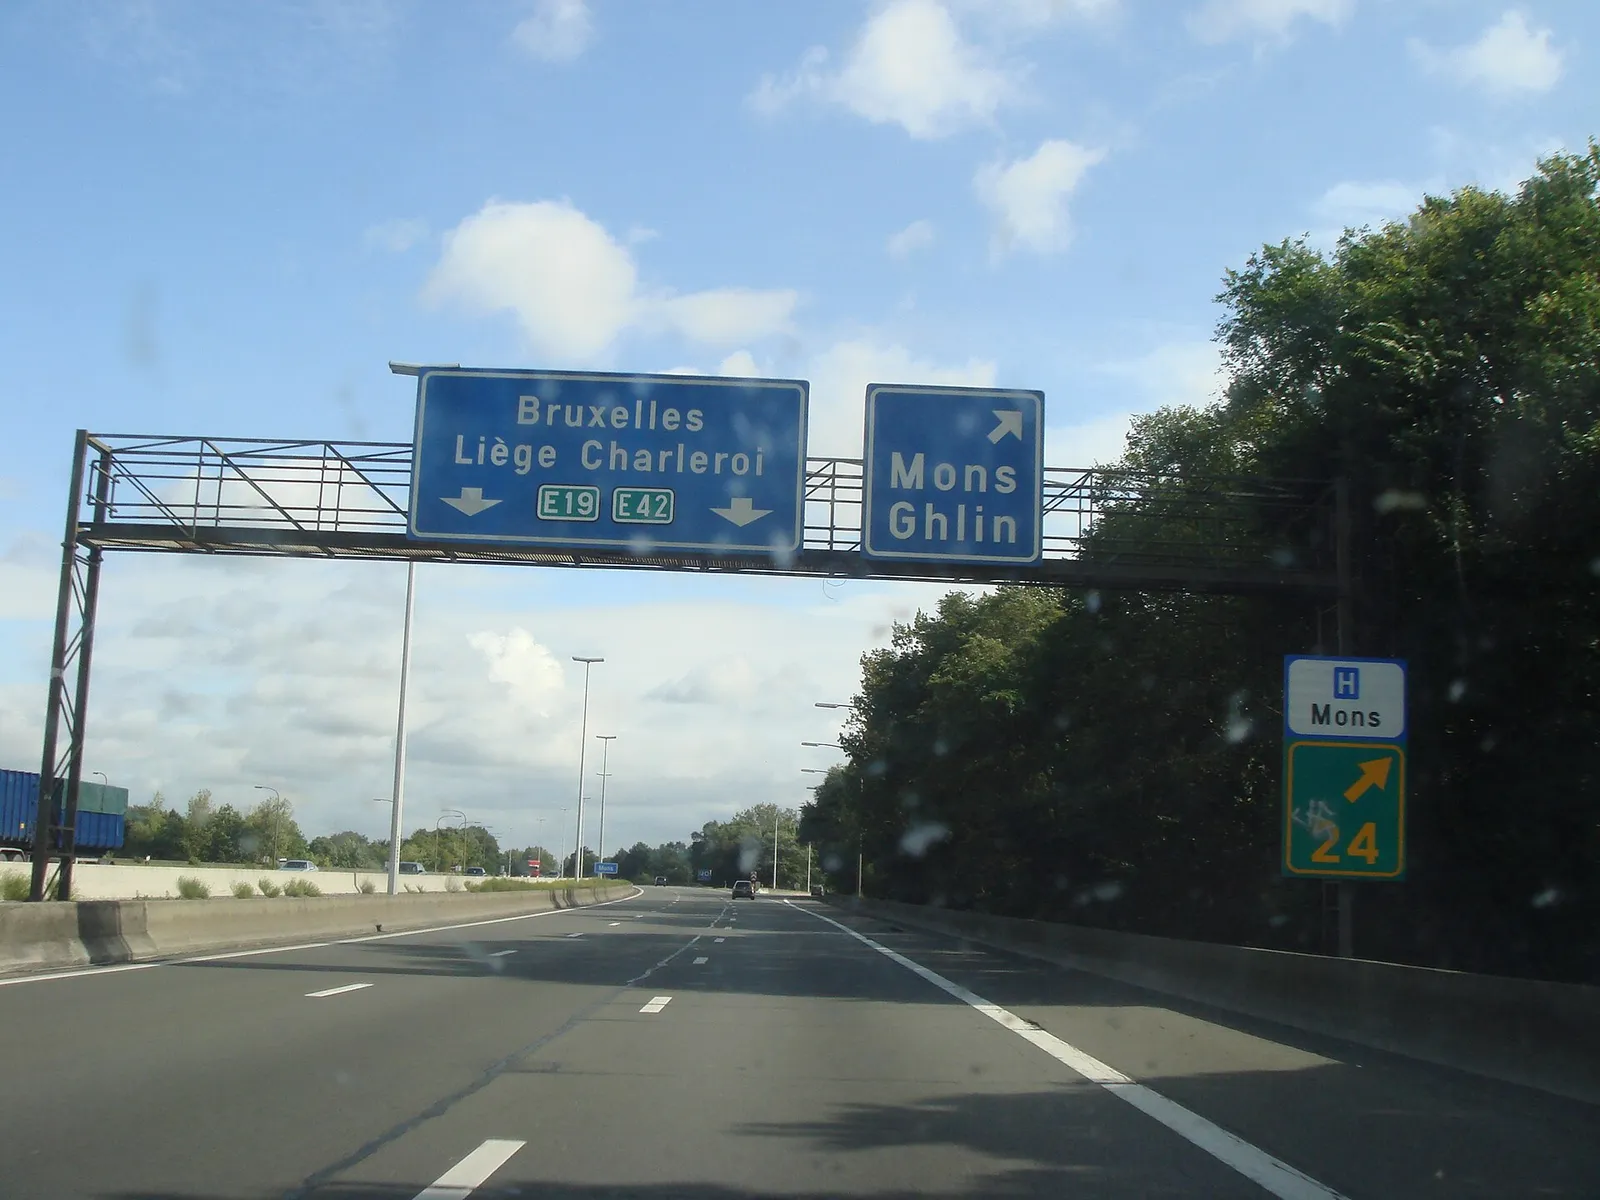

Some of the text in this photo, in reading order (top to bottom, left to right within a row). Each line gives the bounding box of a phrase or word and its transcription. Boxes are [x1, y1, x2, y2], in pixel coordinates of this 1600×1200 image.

[517, 395, 704, 432] Bruxelles
[454, 434, 764, 477] Liège Charleroi
[890, 451, 1017, 494] Mons
[543, 490, 669, 518] E19 E42
[889, 500, 1016, 544] Ghlin
[1338, 672, 1355, 695] H
[1311, 703, 1382, 728] Mons
[1311, 819, 1379, 865] 24
